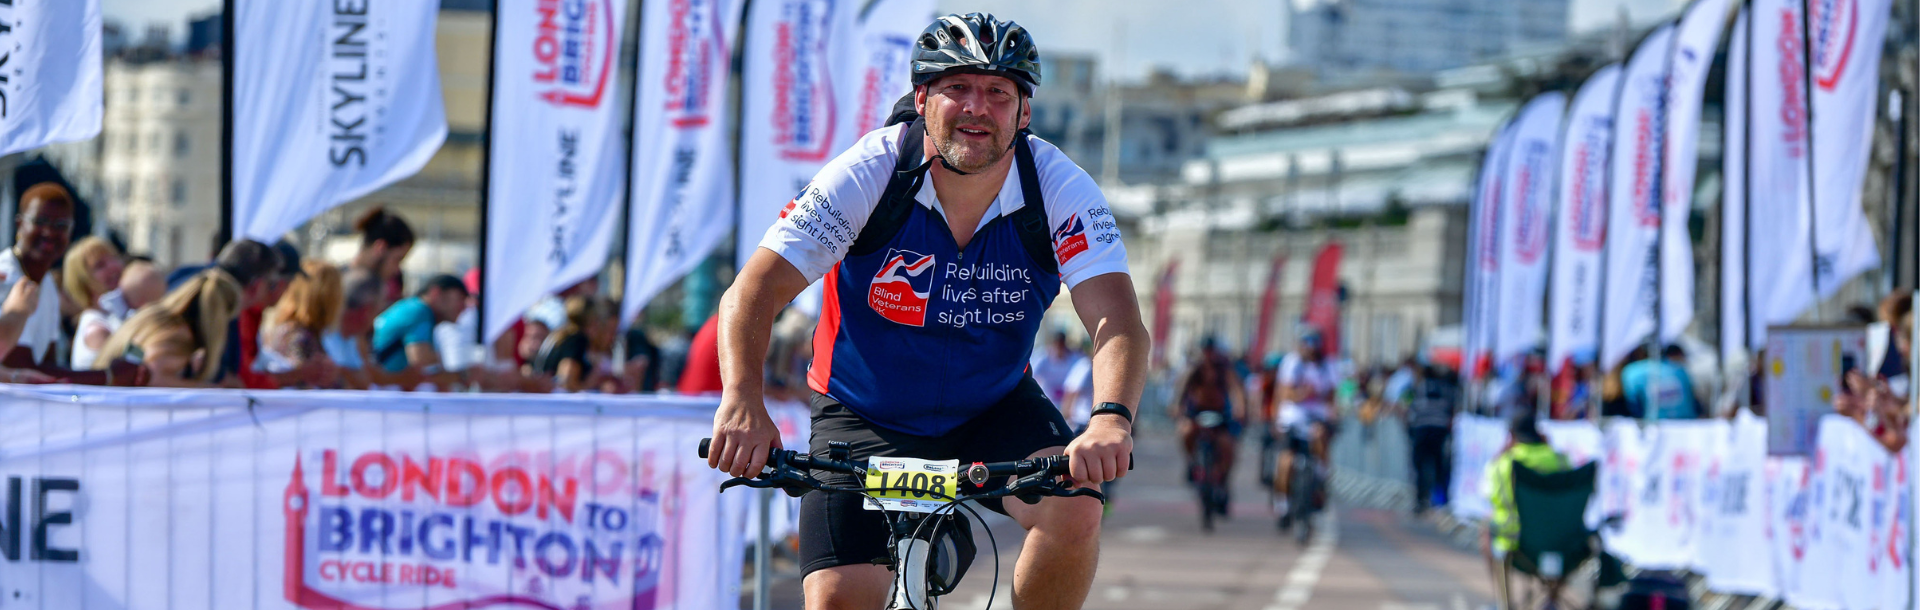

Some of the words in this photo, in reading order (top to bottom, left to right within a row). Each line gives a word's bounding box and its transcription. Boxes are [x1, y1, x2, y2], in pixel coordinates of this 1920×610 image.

[533, 0, 560, 82] LON
[329, 0, 369, 168] SKYLINE
[800, 200, 823, 223] lives
[823, 221, 847, 244] after
[810, 187, 857, 240] Rebuilding
[790, 214, 818, 237] sight
[817, 231, 838, 254] loss
[871, 294, 922, 313] Veterans
[873, 286, 902, 302] Blind
[942, 284, 977, 304] lives
[982, 288, 1029, 304] after
[938, 308, 982, 328] sight
[987, 308, 1025, 324] loss
[321, 447, 578, 524] LONDON
[585, 503, 629, 532] TO
[879, 472, 946, 500] 1408
[318, 506, 624, 588] BRIGHTON
[319, 559, 395, 584] CYCLE
[399, 563, 457, 589] RIDE
